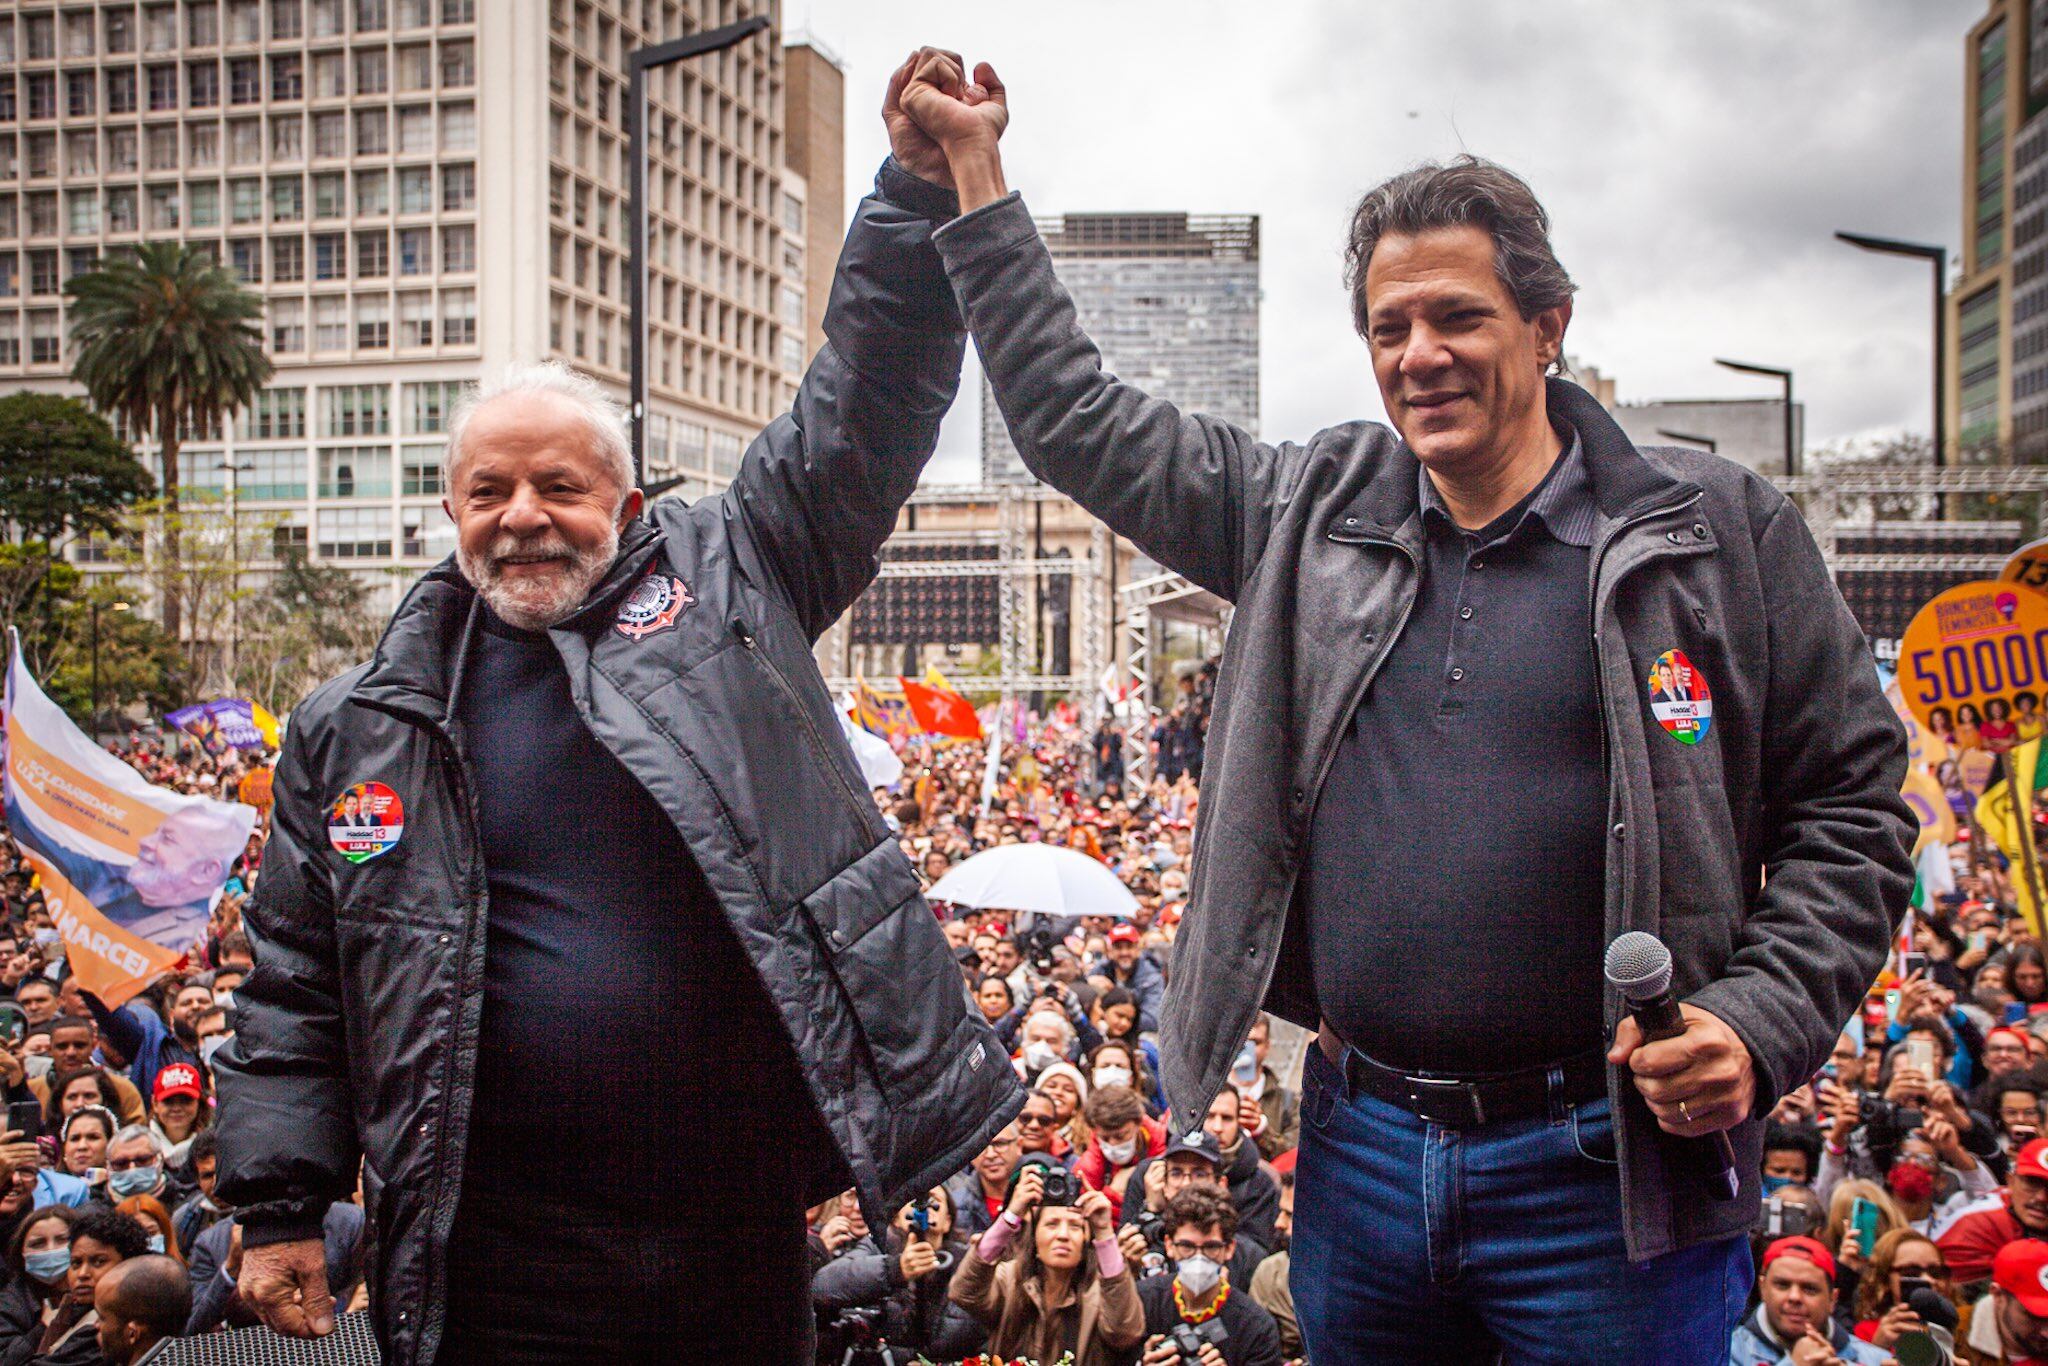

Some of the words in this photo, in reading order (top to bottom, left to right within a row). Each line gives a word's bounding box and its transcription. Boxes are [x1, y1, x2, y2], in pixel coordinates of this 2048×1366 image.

[1935, 593, 1995, 617] BANCADA
[1938, 610, 1999, 635] FEMINISTA
[373, 828, 386, 839] 13
[349, 842, 371, 850] LULA
